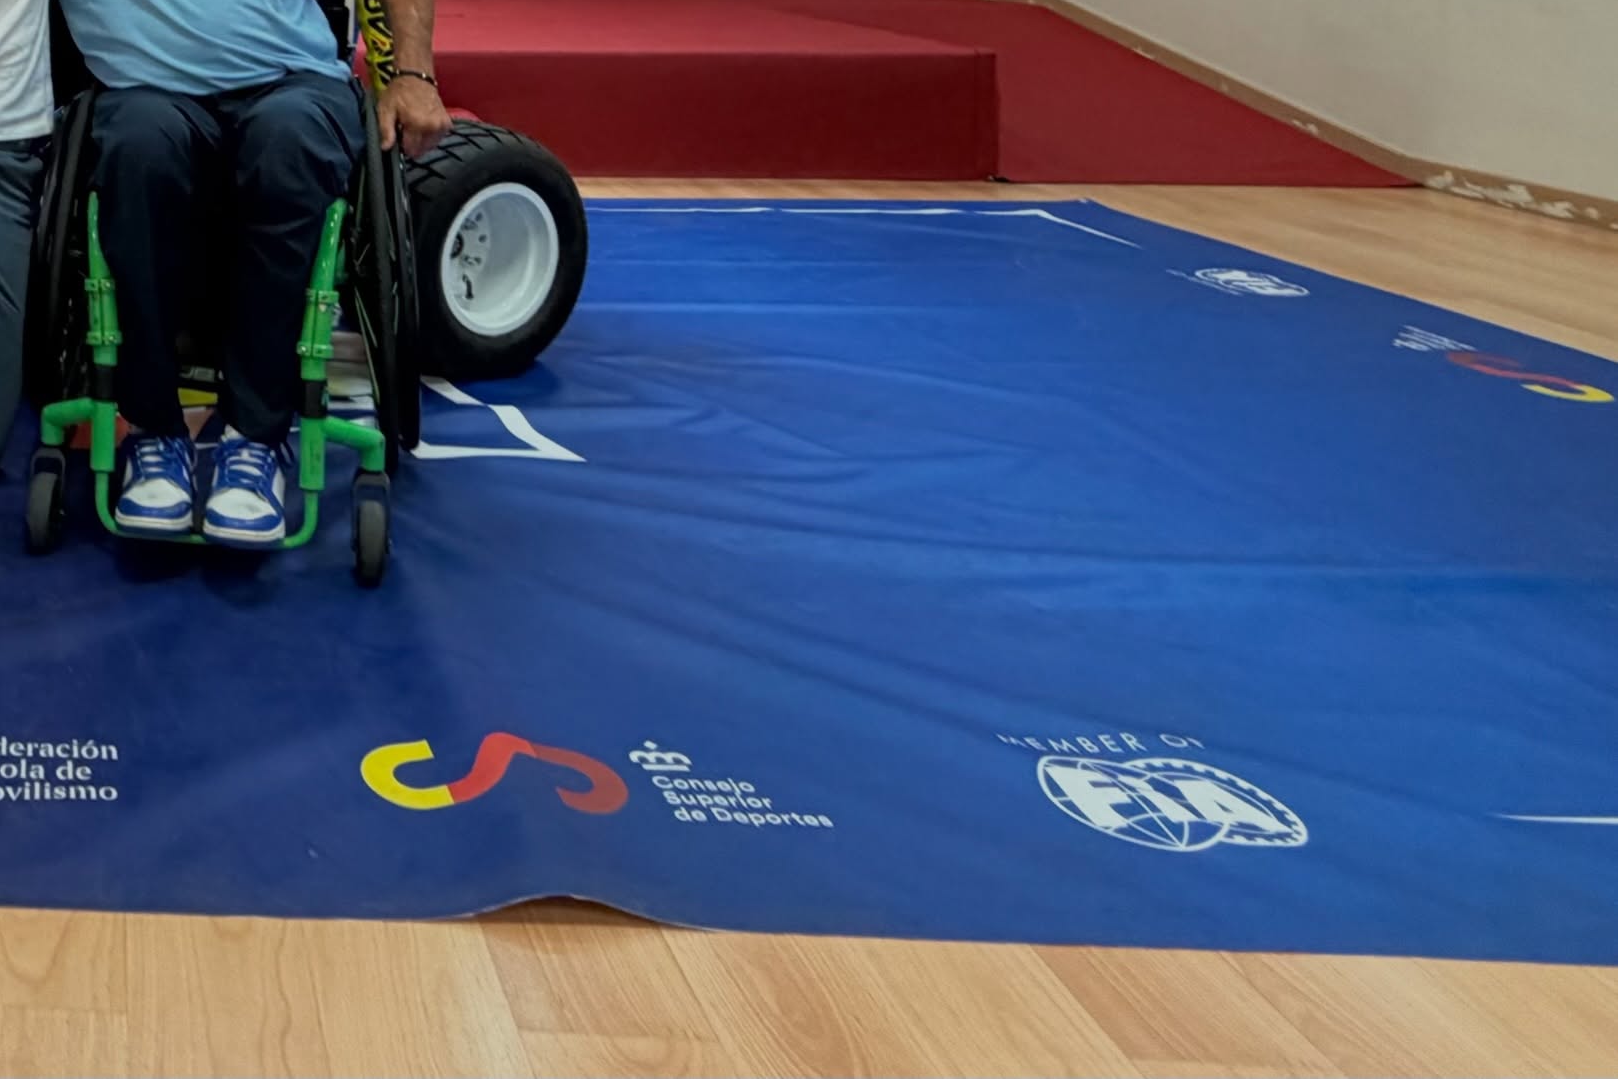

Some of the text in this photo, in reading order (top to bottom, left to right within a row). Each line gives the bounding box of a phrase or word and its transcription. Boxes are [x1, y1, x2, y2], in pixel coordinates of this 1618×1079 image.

[56, 760, 93, 781] de
[652, 775, 756, 795] Consejo
[662, 790, 773, 810] Superior
[1043, 764, 1301, 835] FIA
[674, 806, 834, 829] de Deportes
